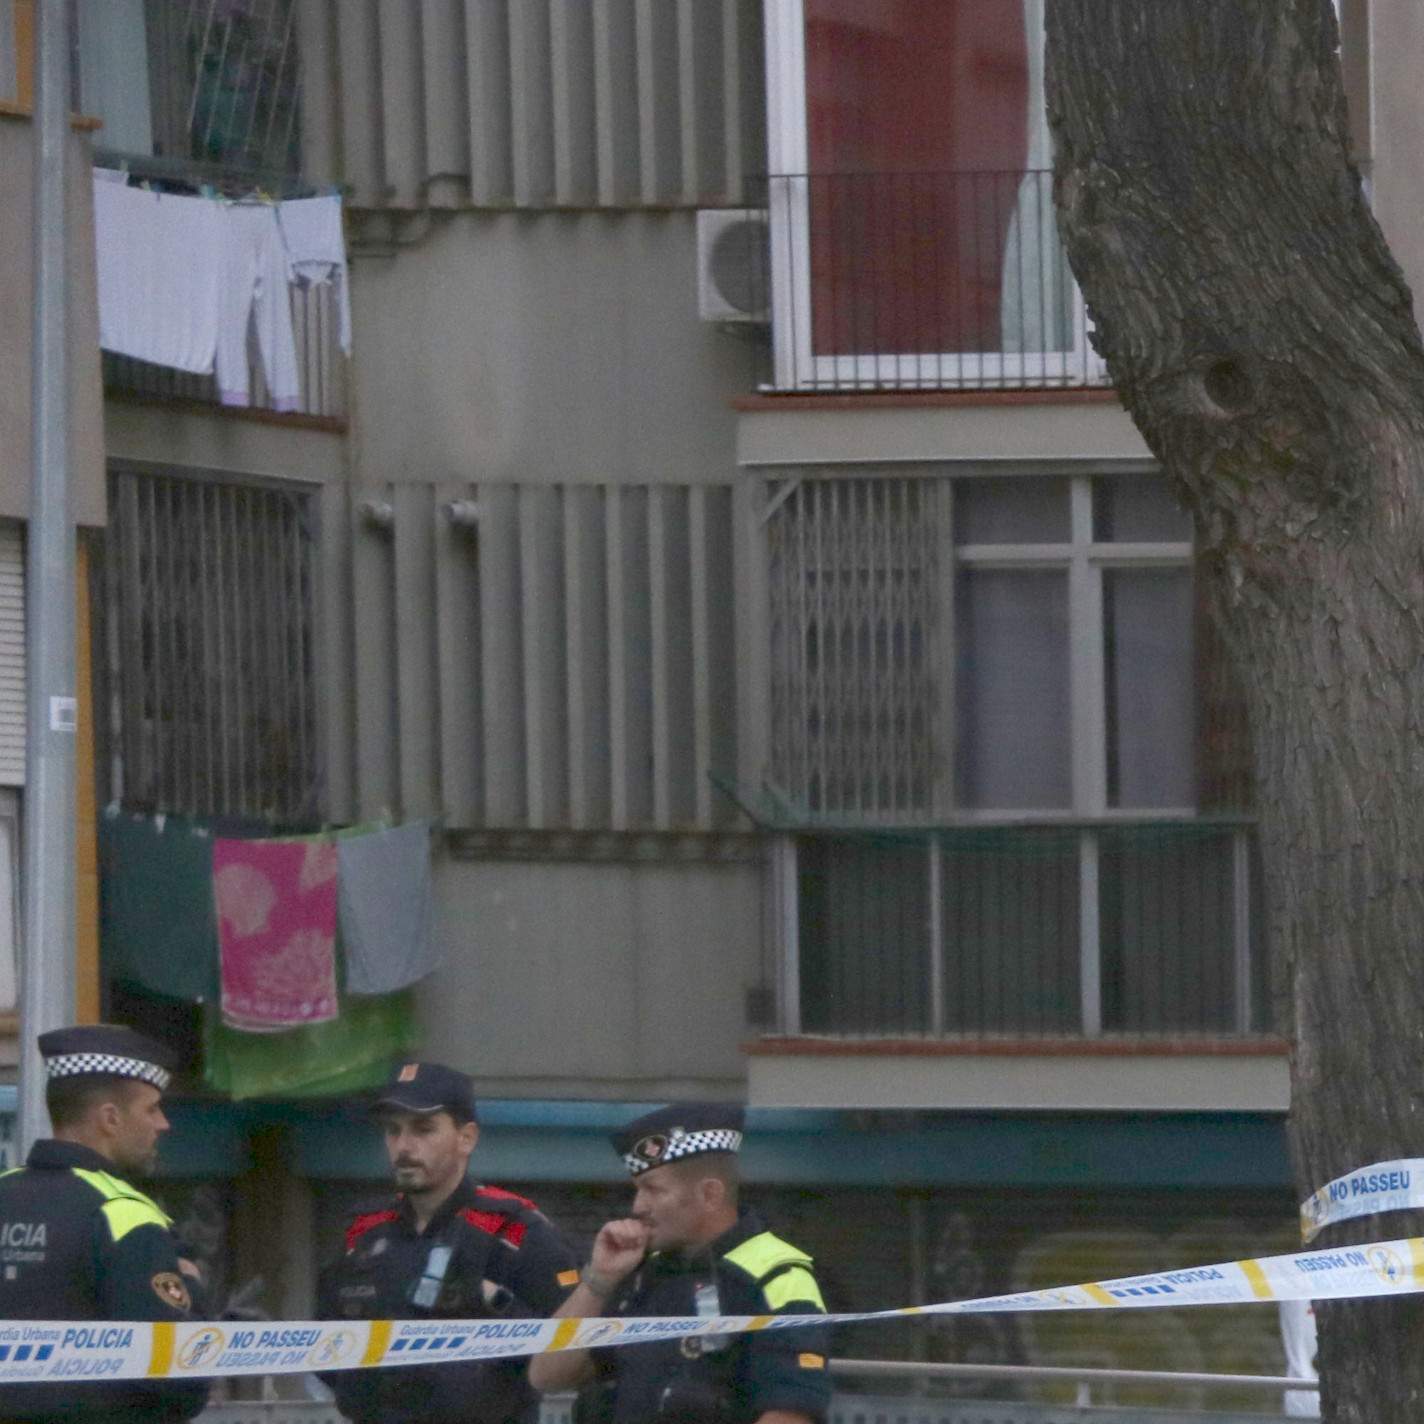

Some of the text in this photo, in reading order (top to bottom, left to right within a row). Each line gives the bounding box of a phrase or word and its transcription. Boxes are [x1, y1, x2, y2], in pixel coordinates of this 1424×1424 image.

[1329, 1171, 1410, 1200] NO PASSEU
[1294, 1254, 1347, 1272] PASSEU
[61, 1328, 133, 1349] POLICIA
[228, 1329, 323, 1349] NO PASSEU
[474, 1323, 543, 1339] POLICIA
